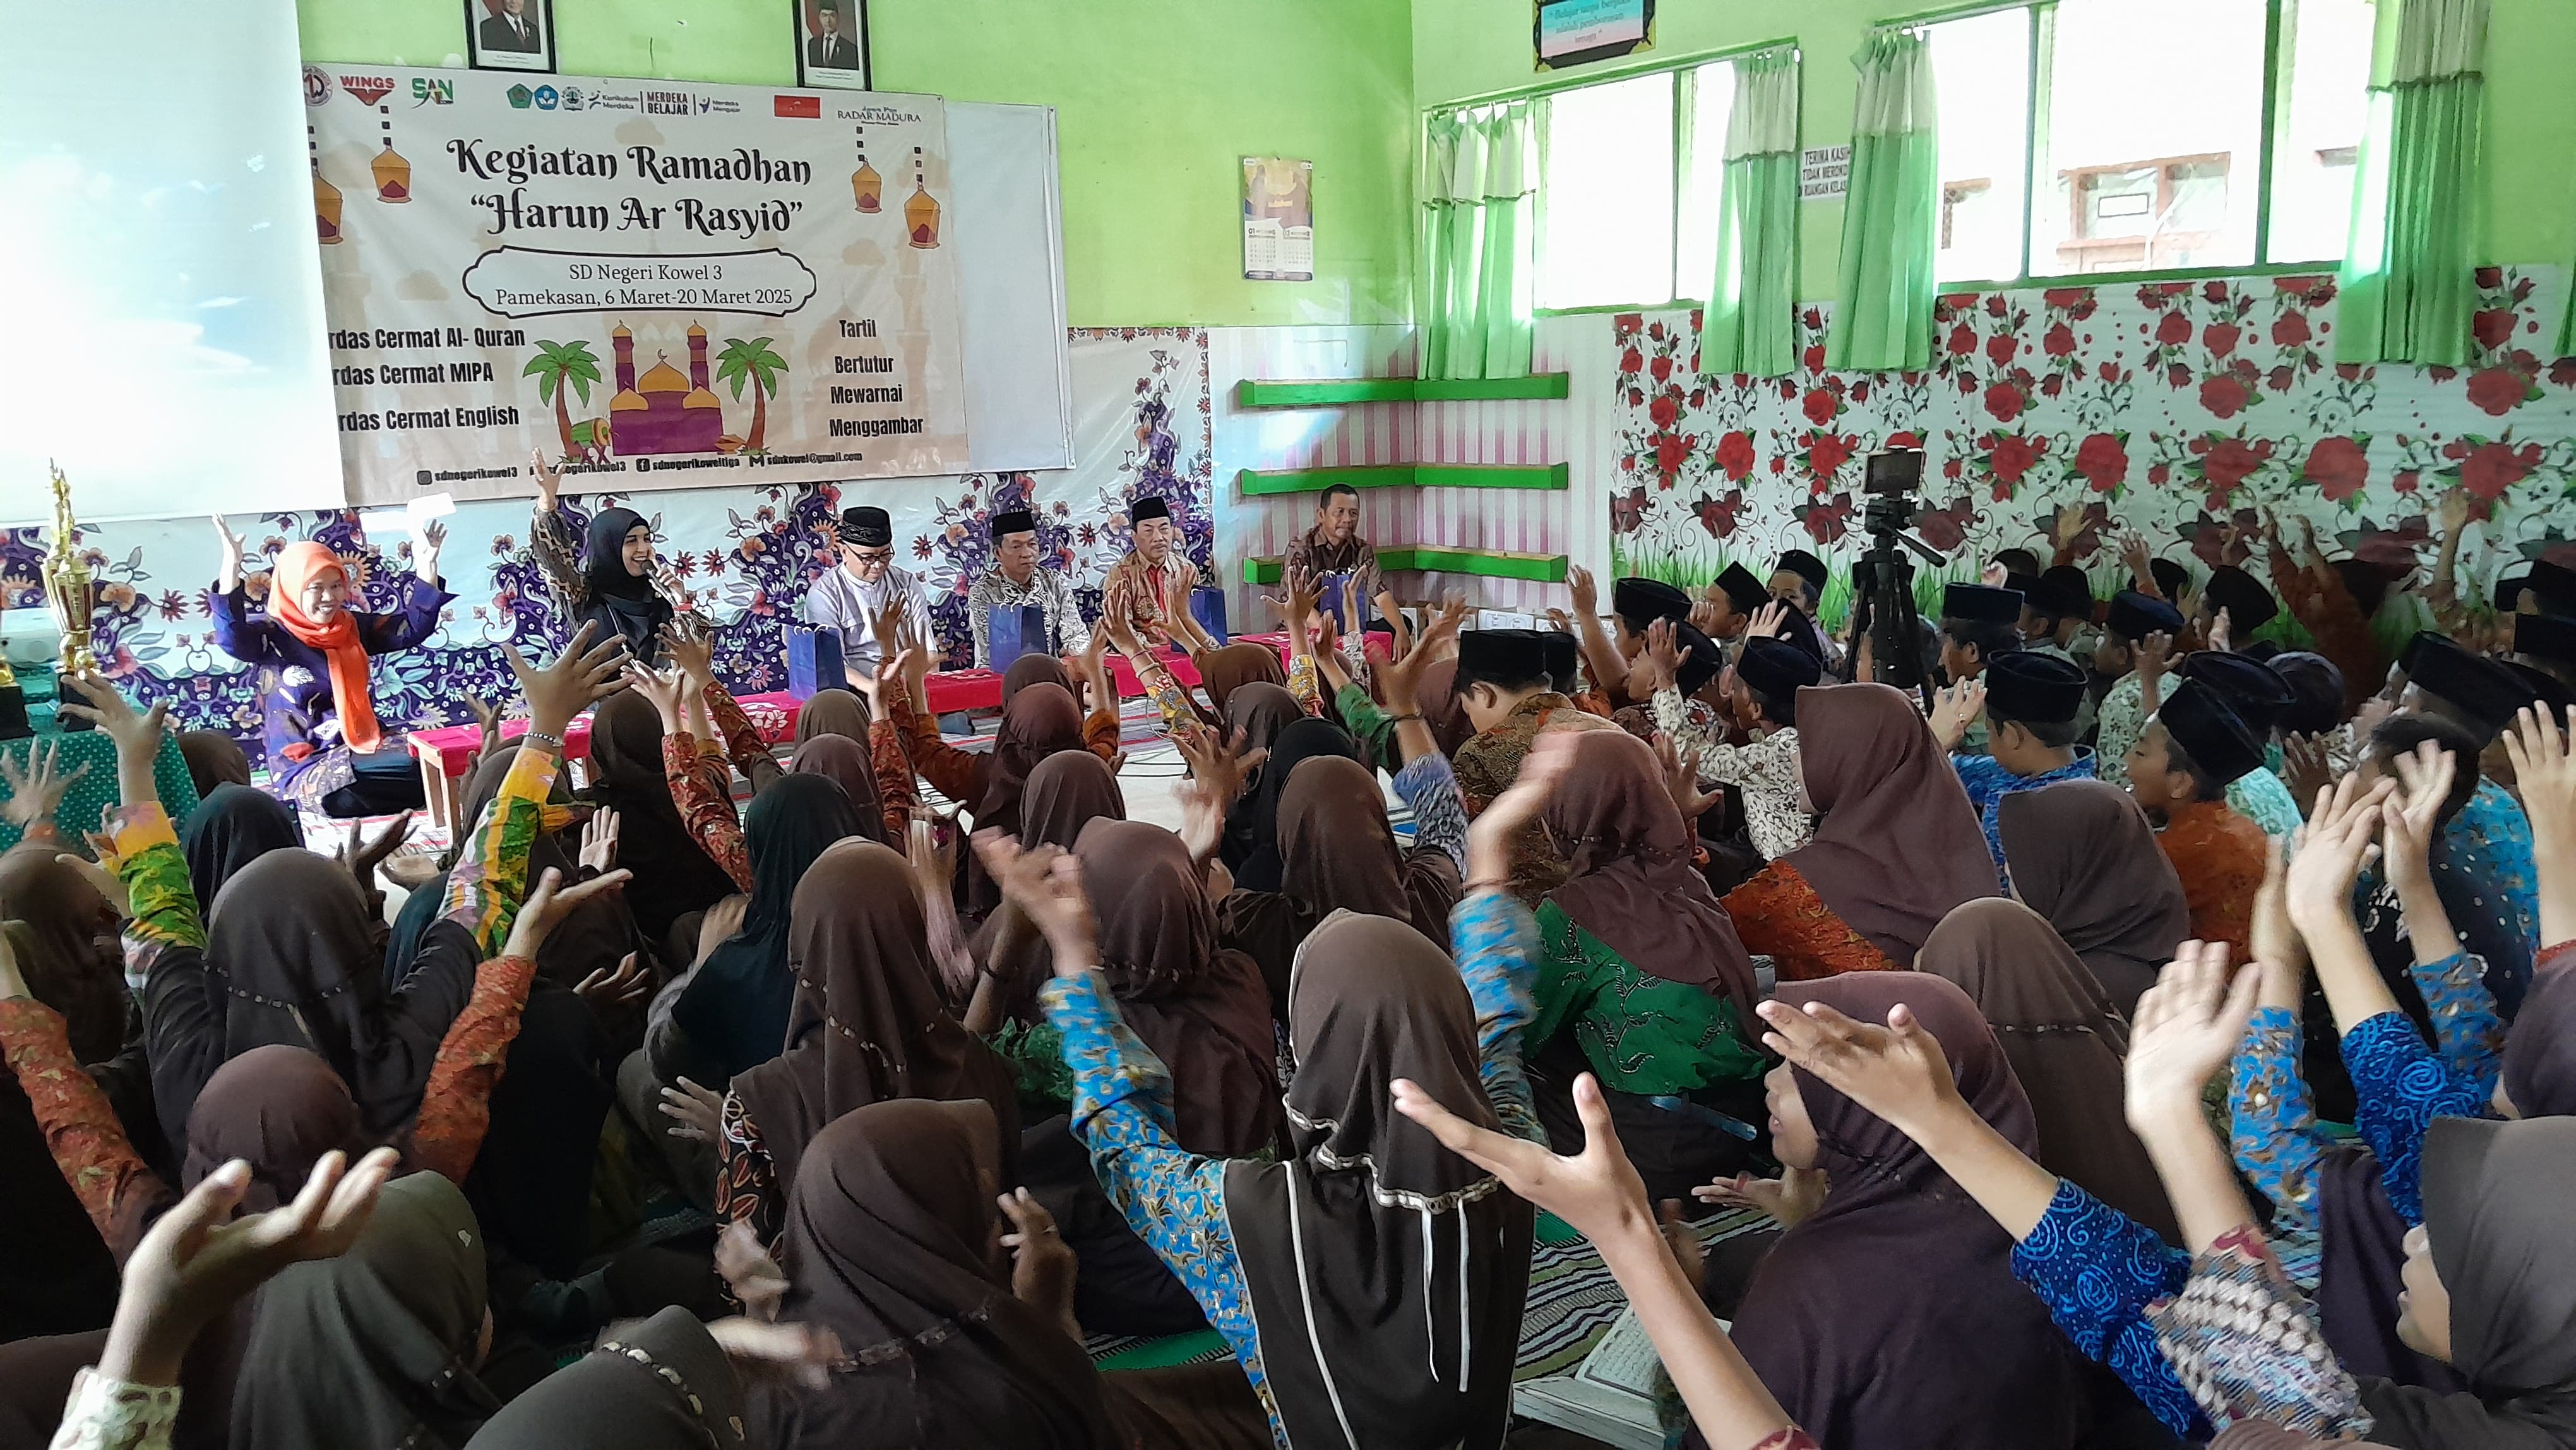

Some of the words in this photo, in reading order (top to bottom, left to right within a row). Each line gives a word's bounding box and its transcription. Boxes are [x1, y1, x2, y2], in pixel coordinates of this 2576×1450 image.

[340, 75, 395, 88] WINGS
[647, 92, 688, 104] MERDEKA
[648, 103, 688, 116] BELAJAR
[838, 110, 873, 120] RADAR
[876, 112, 922, 122] MADURA
[446, 138, 617, 184] Kegiatan
[627, 146, 811, 184] Ramadhan
[617, 197, 665, 231] Ar
[569, 264, 592, 280] SD
[597, 264, 653, 283] Negeri
[657, 264, 708, 280] Kowel
[713, 265, 722, 280] 3
[496, 289, 600, 307] Pamekasan,
[605, 289, 615, 304] 6
[620, 289, 697, 305] Maret-20
[702, 289, 751, 305] Maret
[755, 289, 792, 304] 2025
[329, 330, 370, 349] rdas
[375, 328, 441, 349] Cermat
[446, 328, 468, 347] Al-
[474, 327, 525, 347] Quran
[840, 319, 876, 339] Tartil
[333, 364, 374, 386] rdas
[380, 362, 444, 384] Cermat
[450, 362, 494, 383] MIPA
[835, 356, 894, 374] Bertutur
[830, 384, 903, 404] Mewarnai
[338, 412, 380, 431] rdas
[386, 408, 450, 430] Cermat
[456, 405, 519, 428] English
[830, 416, 924, 438] Menggambar
